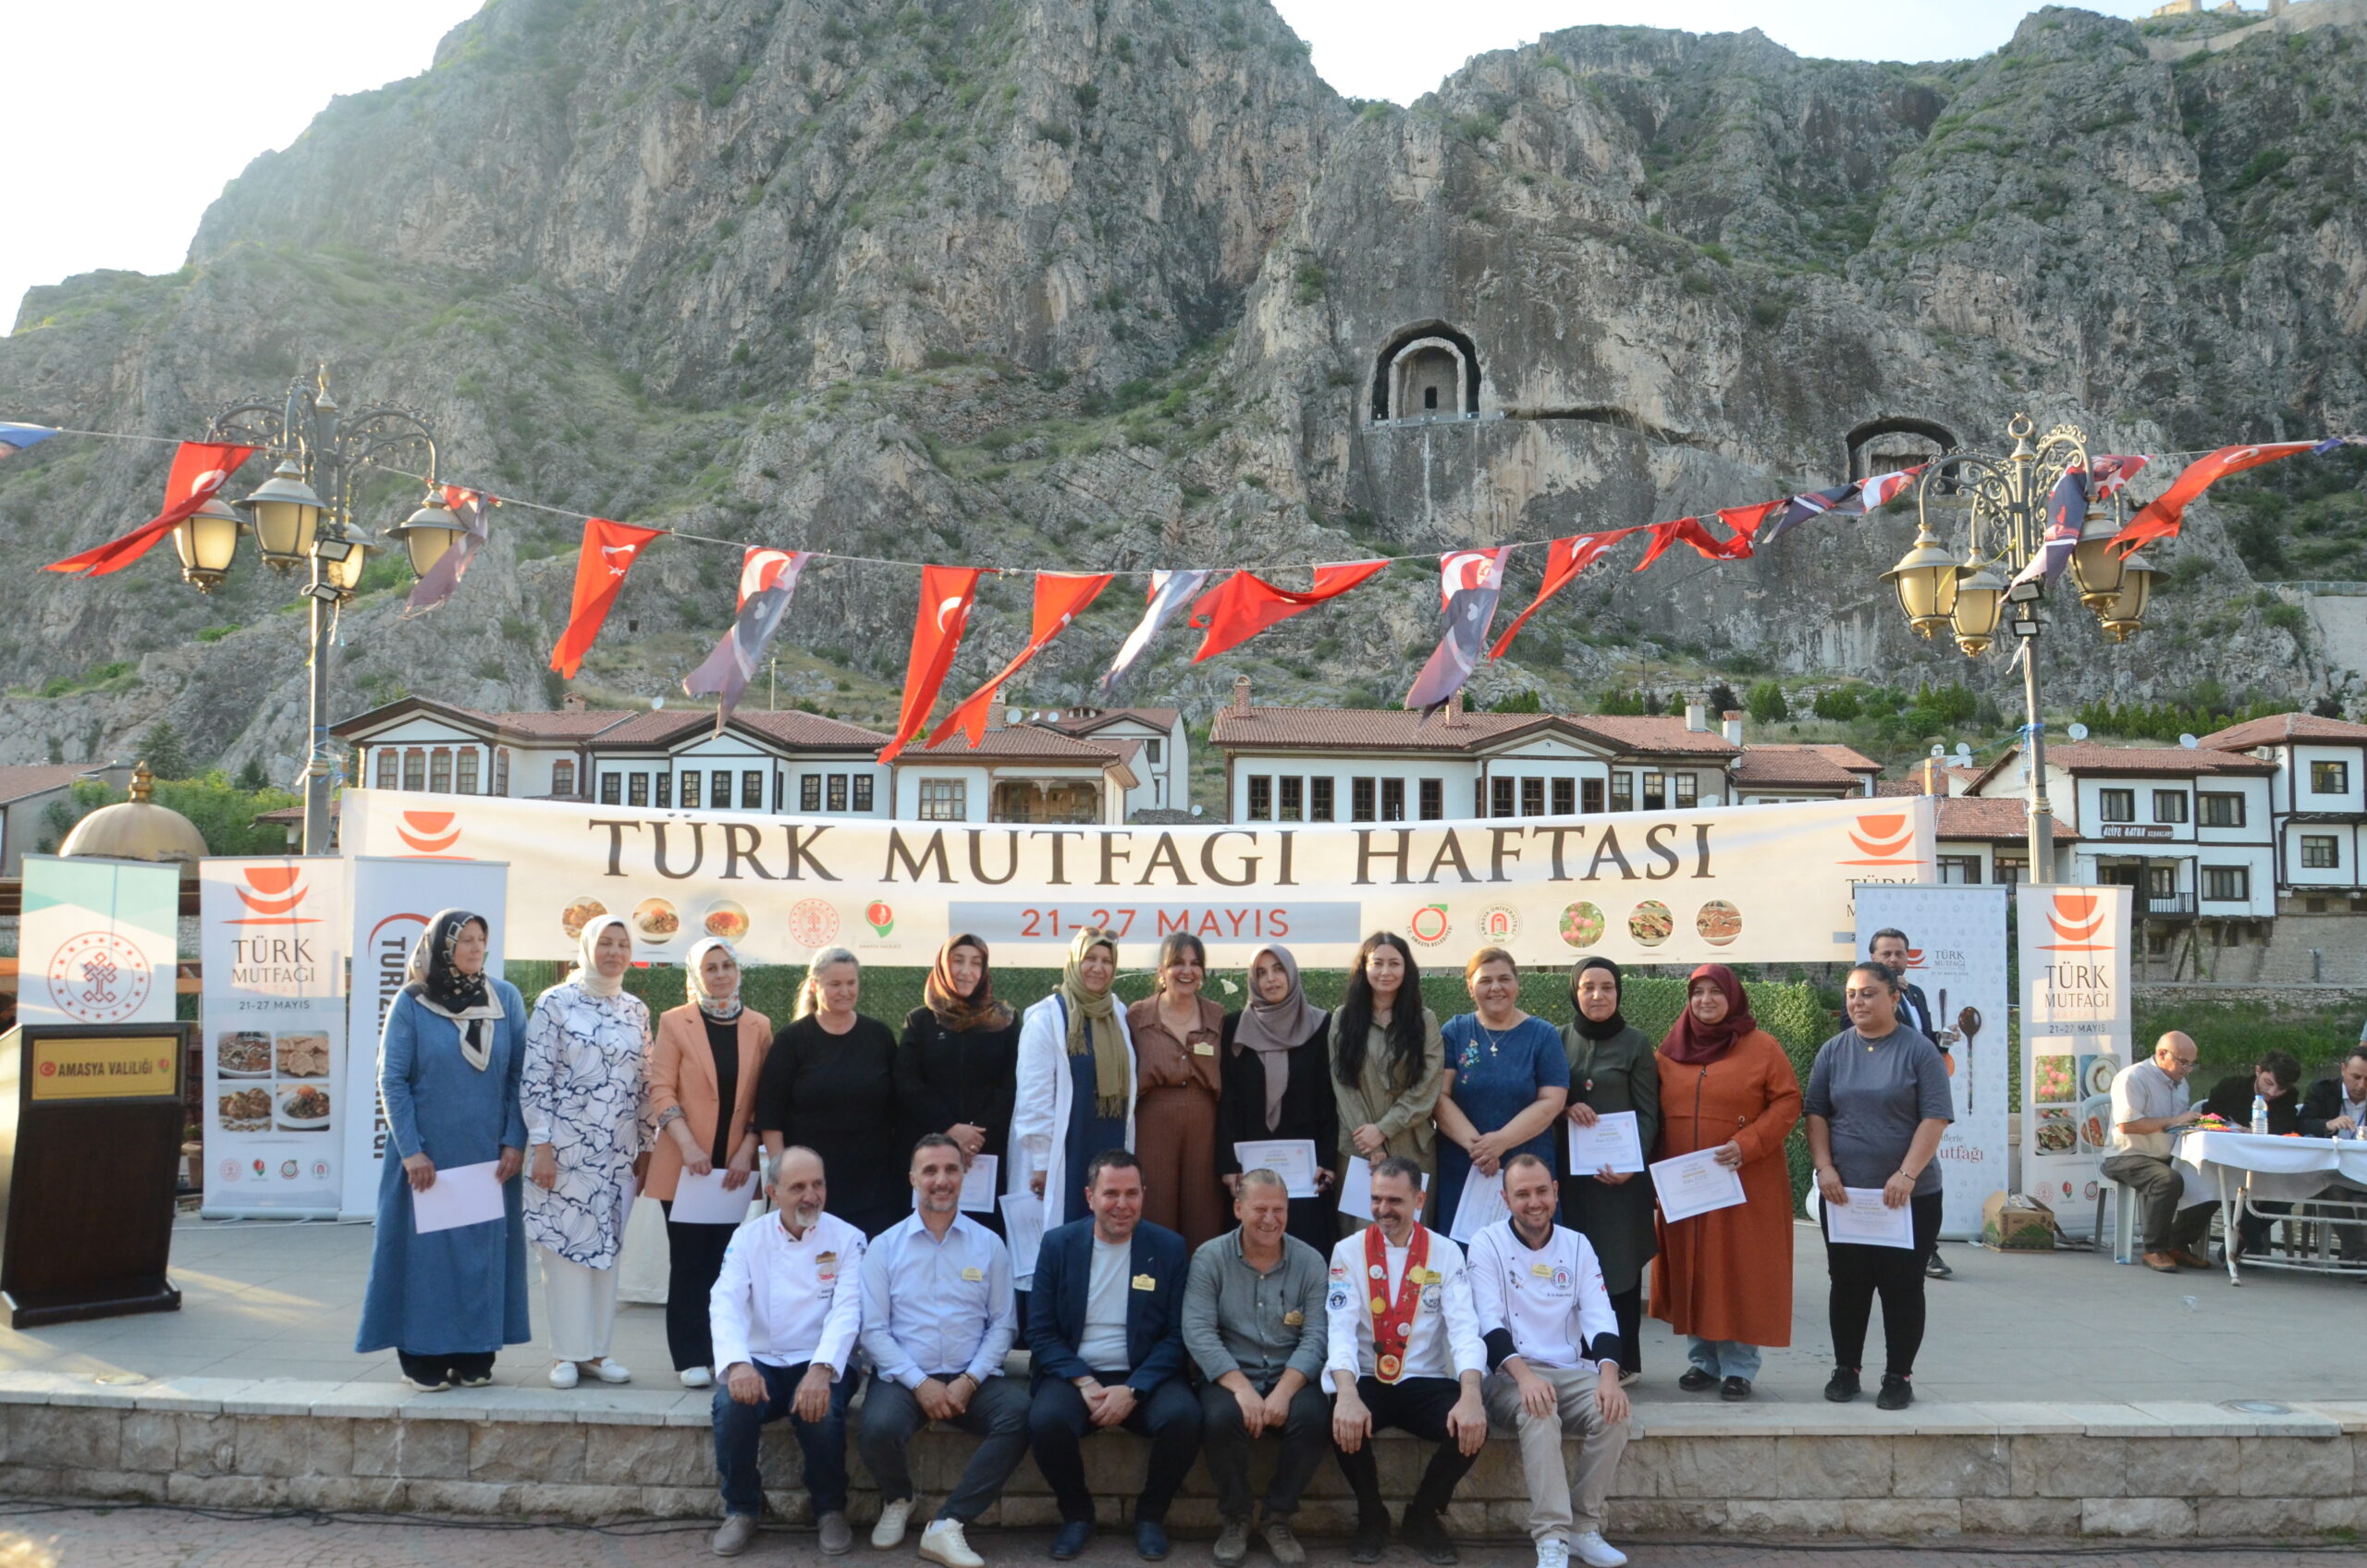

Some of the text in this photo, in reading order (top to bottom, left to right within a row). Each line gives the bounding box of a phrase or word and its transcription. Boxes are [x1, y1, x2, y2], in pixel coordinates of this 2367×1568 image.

[589, 813, 1716, 887] TÜRK MUTFAĞI HAFTASI
[1021, 909, 1289, 937] 21-27 MAYIS
[231, 935, 314, 963] TÜRK
[1934, 949, 1965, 960] TÜRK
[231, 964, 314, 983] MUTFAĞI
[2044, 962, 2108, 988] TÜRK
[239, 1000, 311, 1011] 21-27 MAYIS
[2044, 990, 2109, 1008] MUTFAĞI
[2078, 1023, 2105, 1033] MAYIS
[58, 1062, 104, 1077] AMASYA
